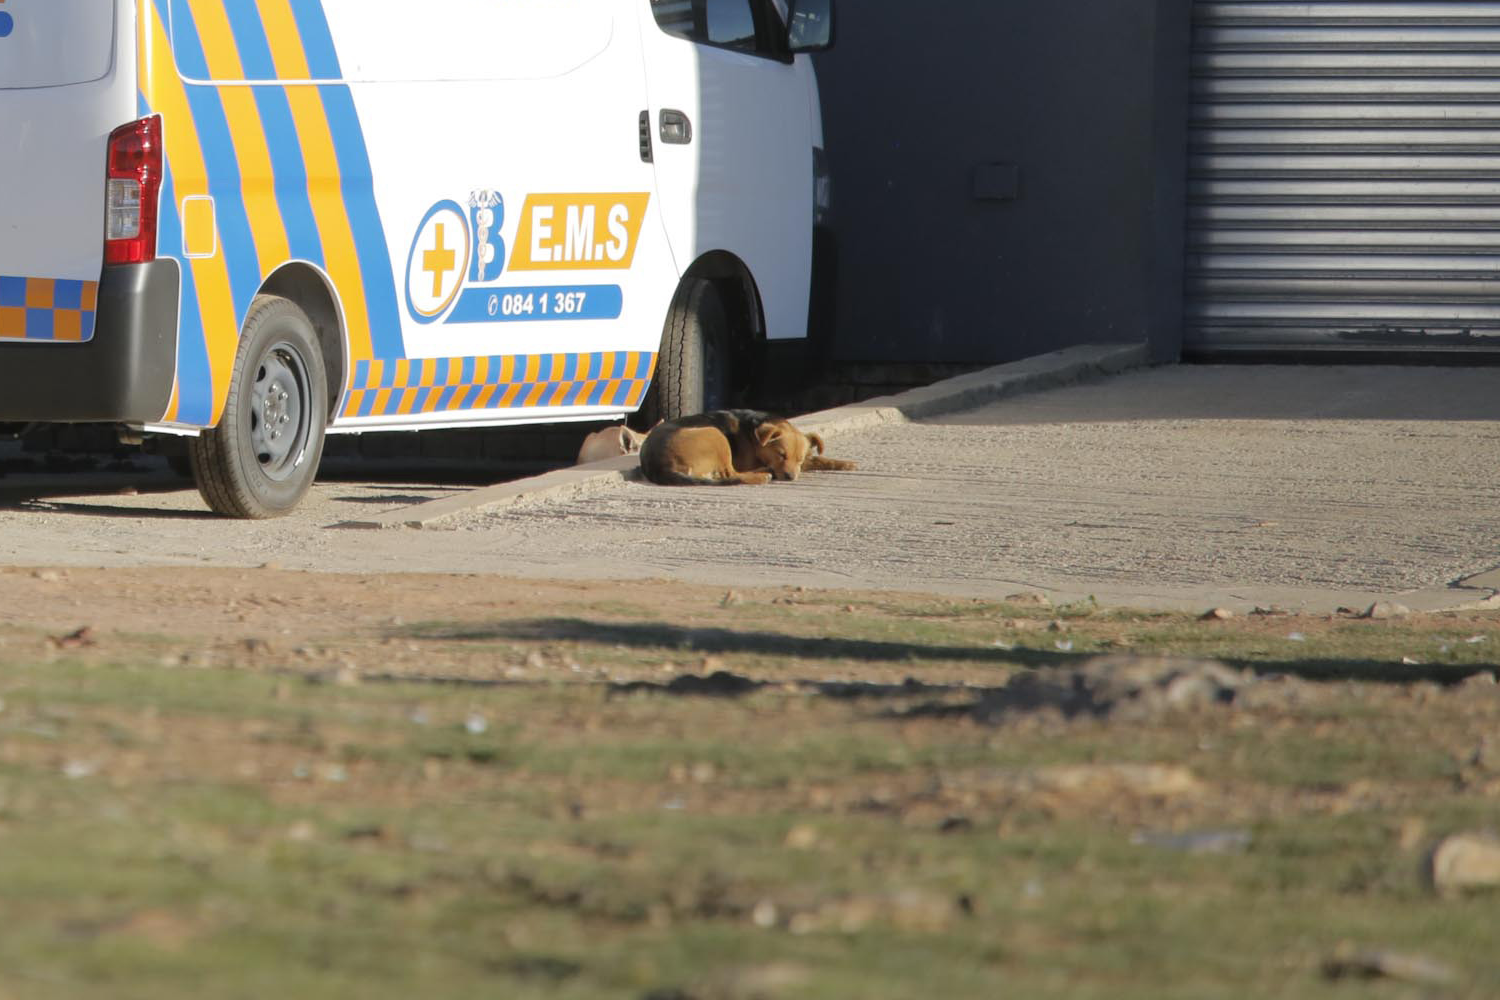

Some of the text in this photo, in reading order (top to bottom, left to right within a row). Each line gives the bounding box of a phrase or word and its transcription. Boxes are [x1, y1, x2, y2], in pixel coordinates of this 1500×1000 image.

[529, 203, 630, 263] E.M.S
[501, 292, 586, 315] 084 1 367
